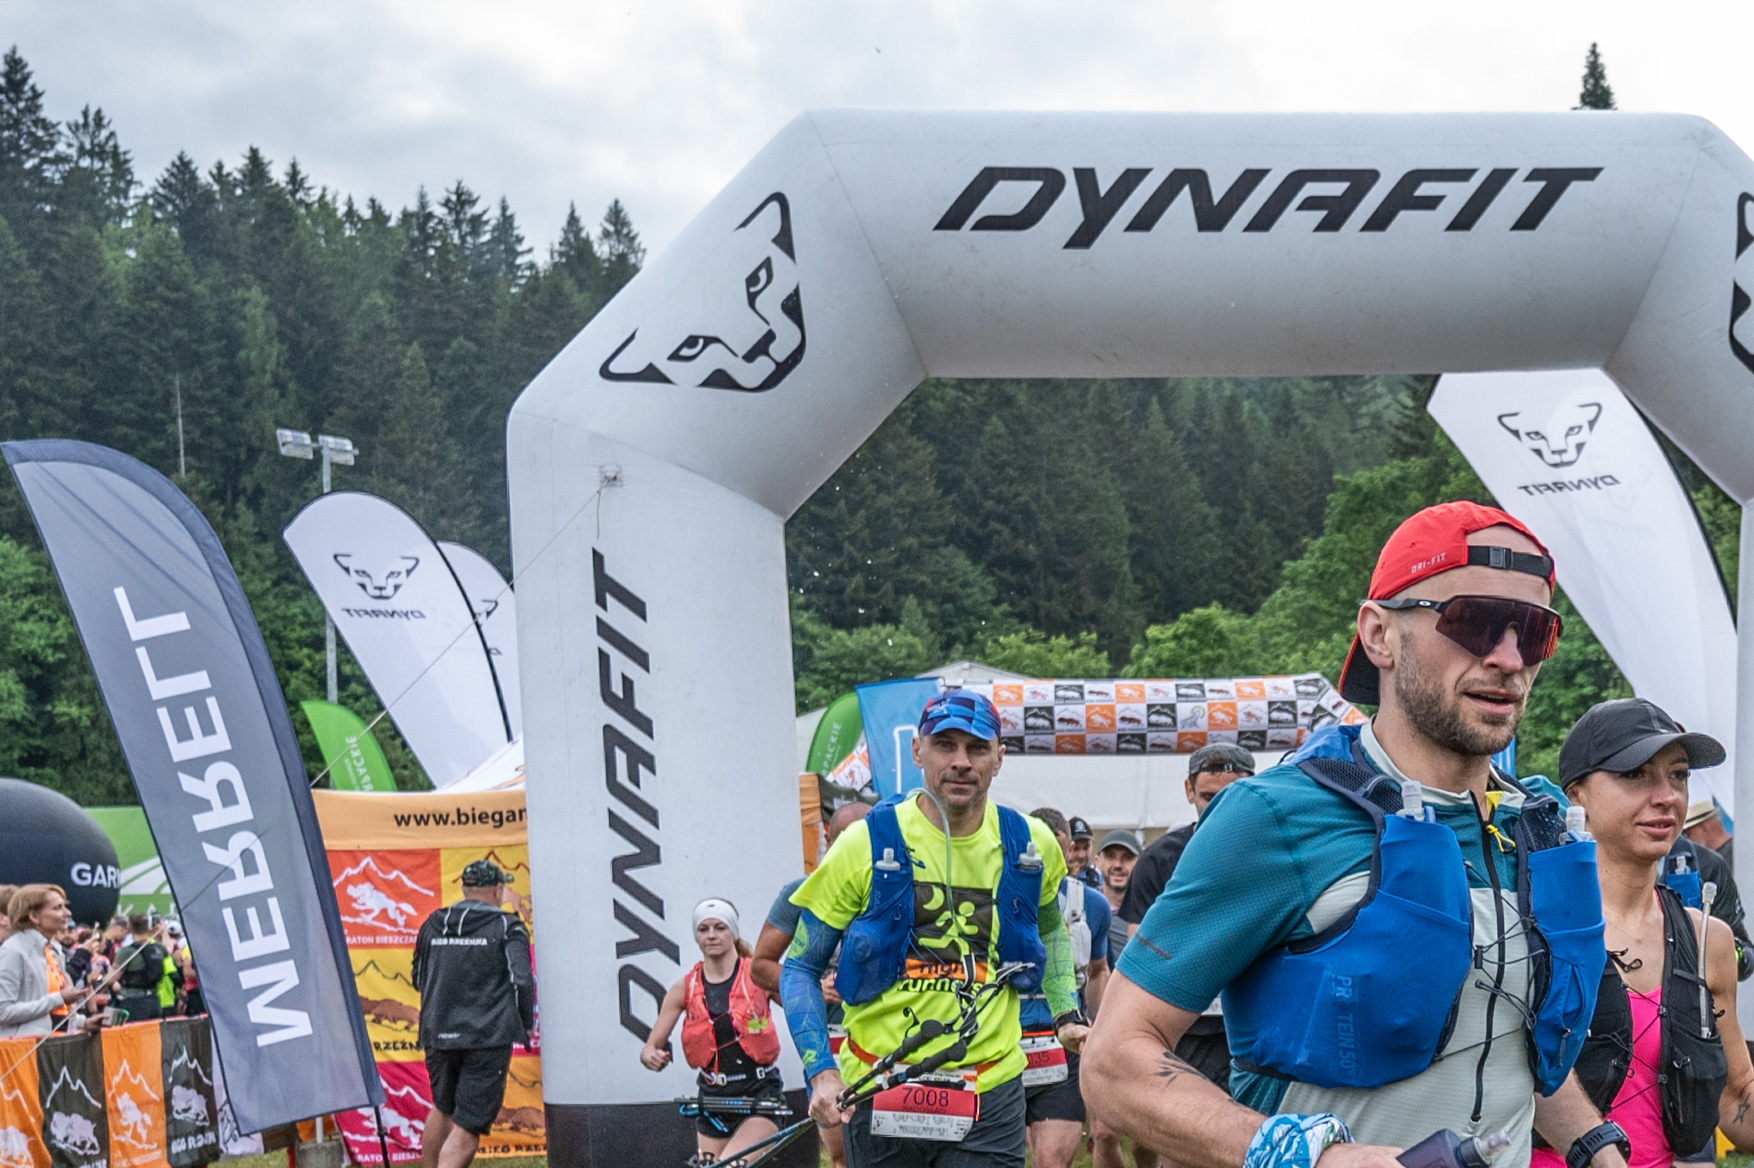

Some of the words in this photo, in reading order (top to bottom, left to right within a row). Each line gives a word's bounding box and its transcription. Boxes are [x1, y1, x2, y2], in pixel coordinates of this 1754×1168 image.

[933, 167, 1604, 250] DYNAFIT
[1411, 552, 1446, 574] DRI-FIT
[821, 722, 842, 777] RPACKIE
[592, 547, 681, 1064] DYNAFIT
[346, 935, 374, 945] RATON
[898, 976, 984, 995] runnes
[1335, 974, 1356, 1049] PRTEIN
[902, 1087, 949, 1107] 7008
